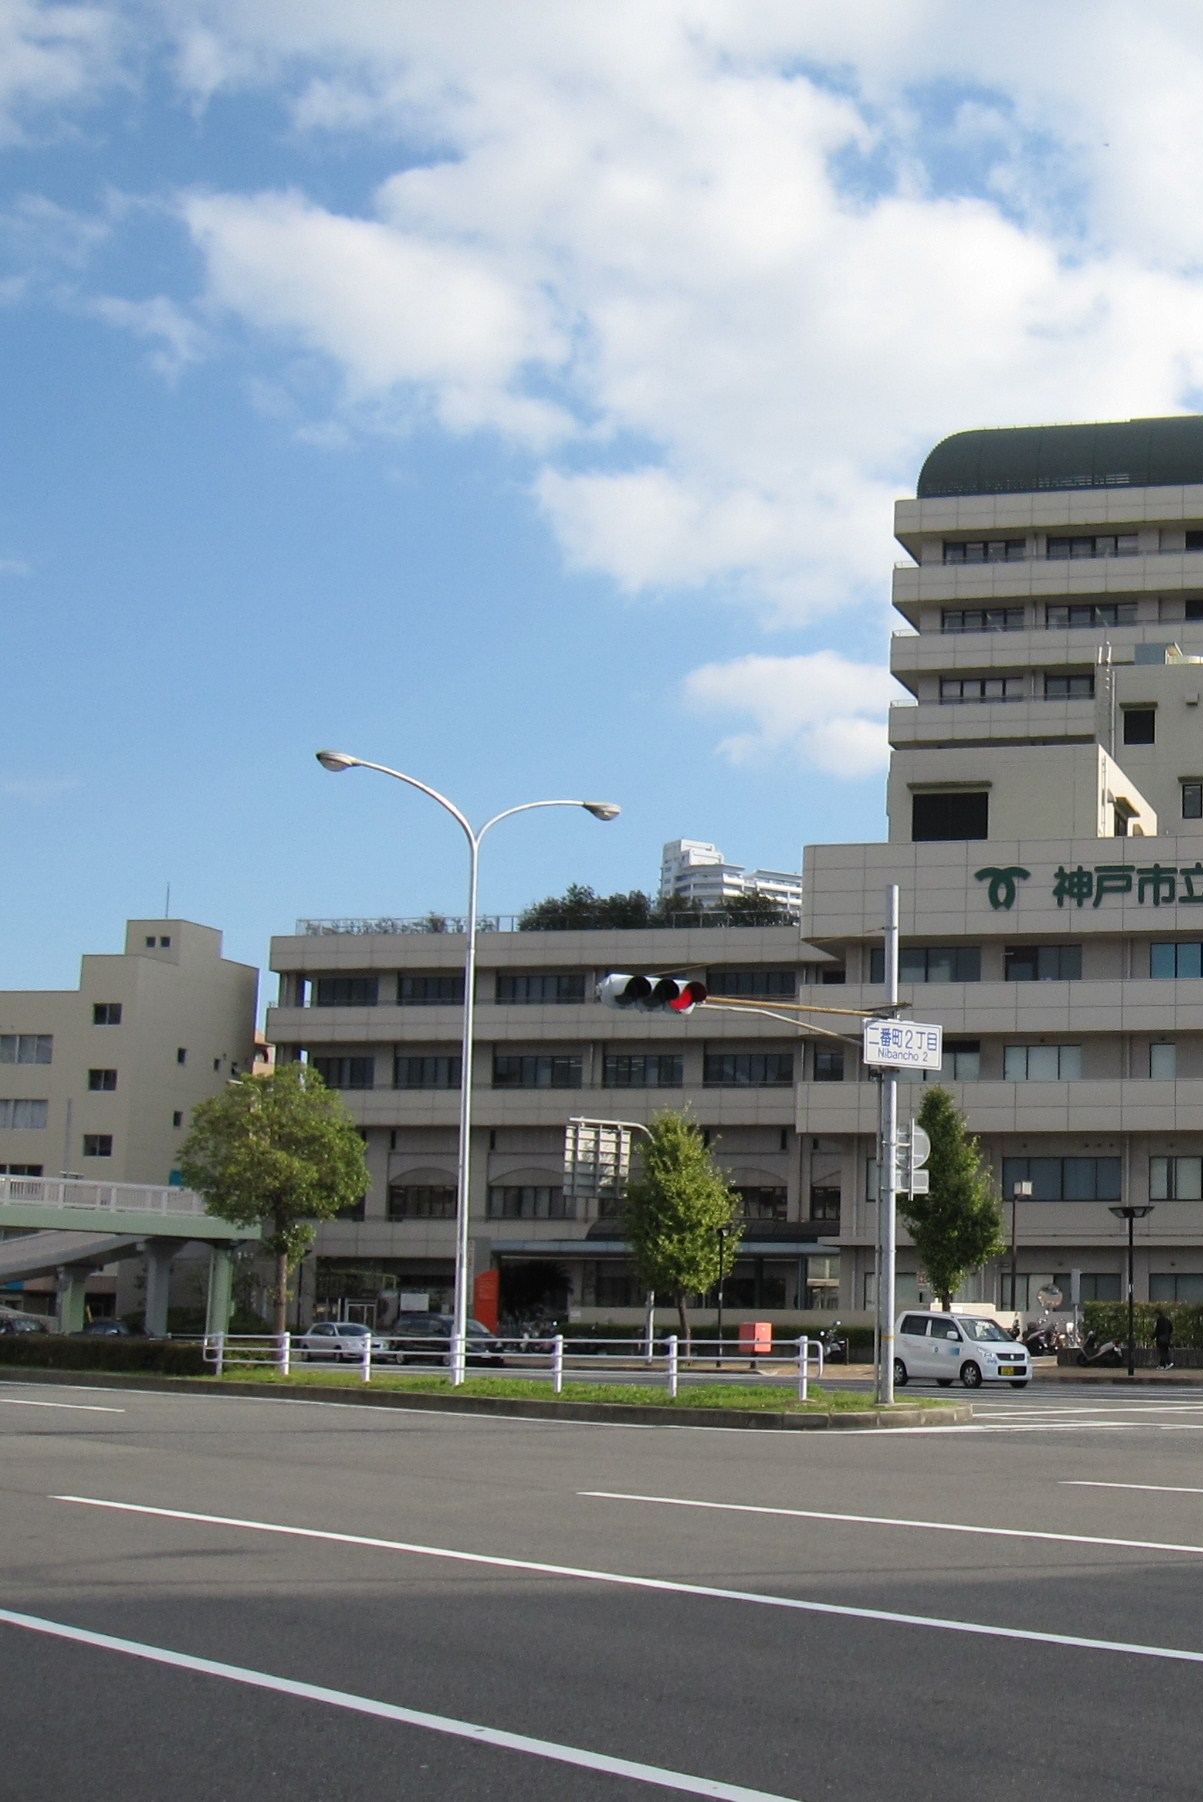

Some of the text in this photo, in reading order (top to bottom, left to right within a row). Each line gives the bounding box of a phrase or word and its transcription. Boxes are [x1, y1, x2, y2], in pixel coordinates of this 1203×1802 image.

[868, 1027, 937, 1051] 二番町2丁目
[878, 1048, 928, 1062] Nibancho 2
